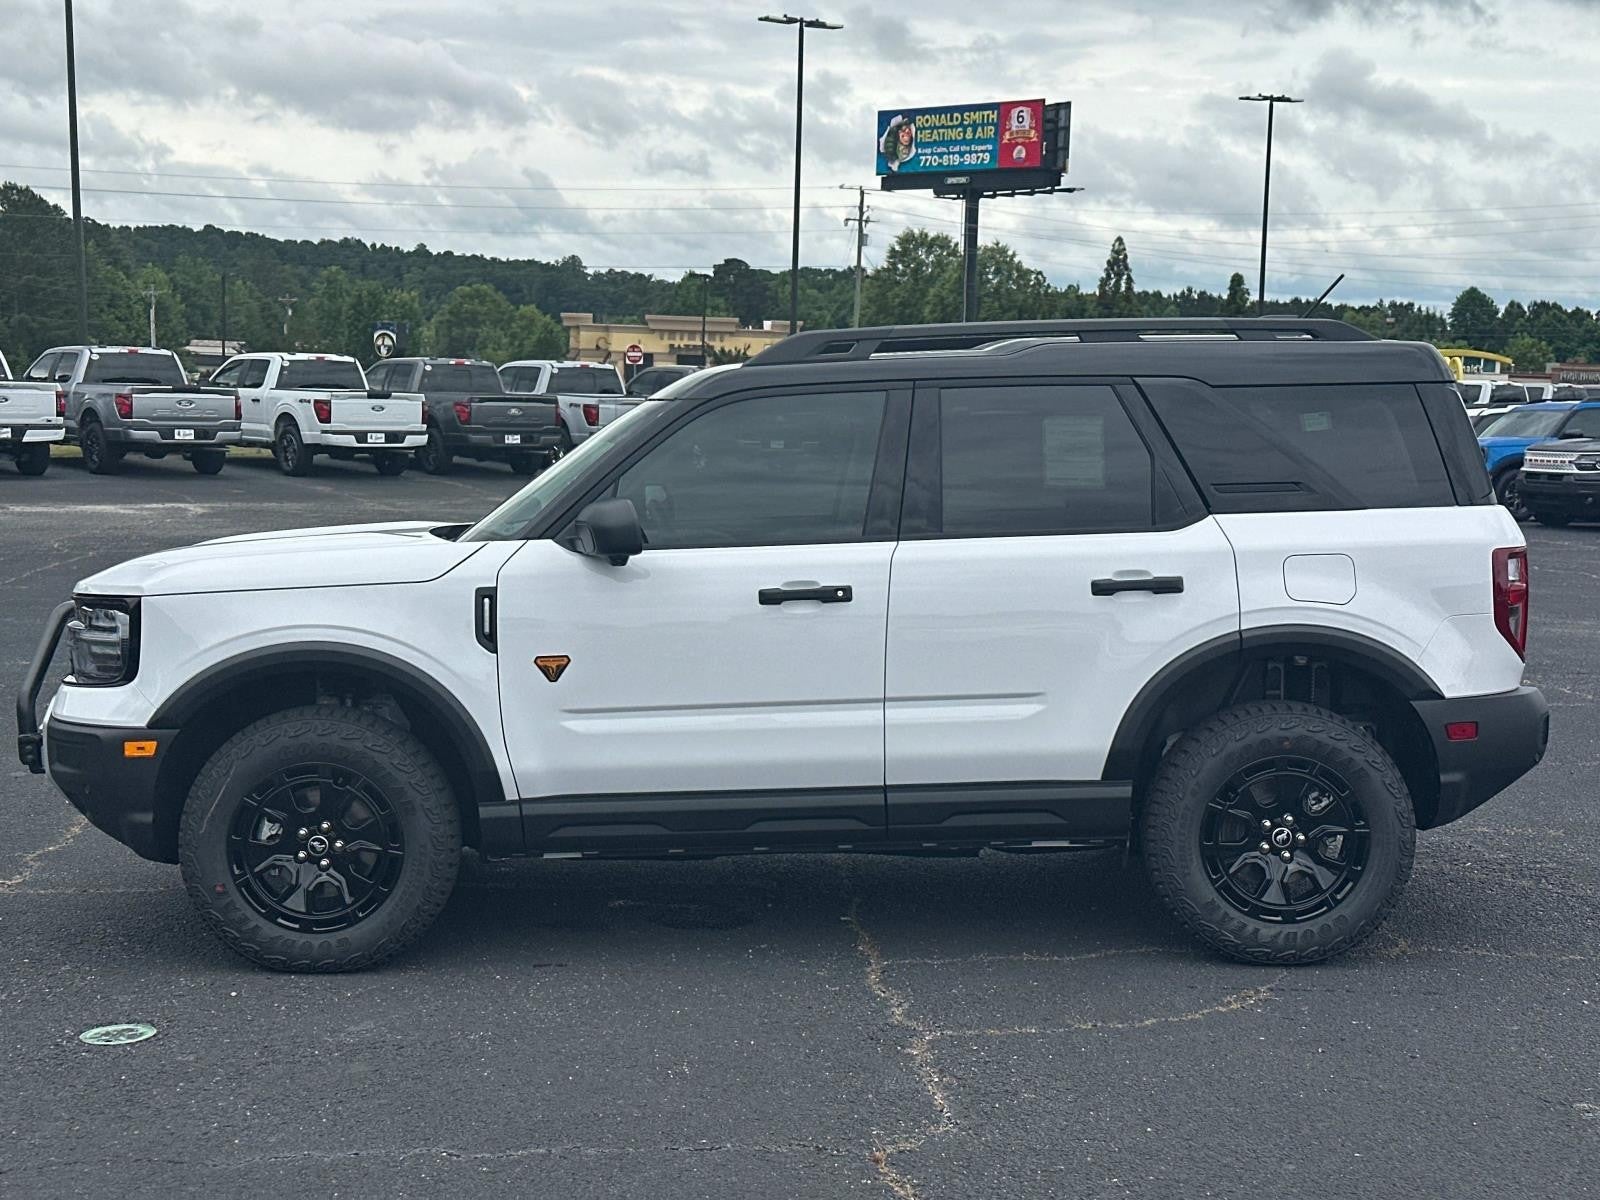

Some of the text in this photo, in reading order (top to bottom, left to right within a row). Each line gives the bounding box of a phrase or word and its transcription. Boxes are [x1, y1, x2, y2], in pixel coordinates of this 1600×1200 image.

[916, 110, 997, 128] RONALD SMITH
[1016, 109, 1025, 124] 6
[917, 127, 963, 142] HEATING
[965, 127, 973, 139] &
[975, 125, 995, 139] AIR
[920, 153, 990, 166] 770-819-9879
